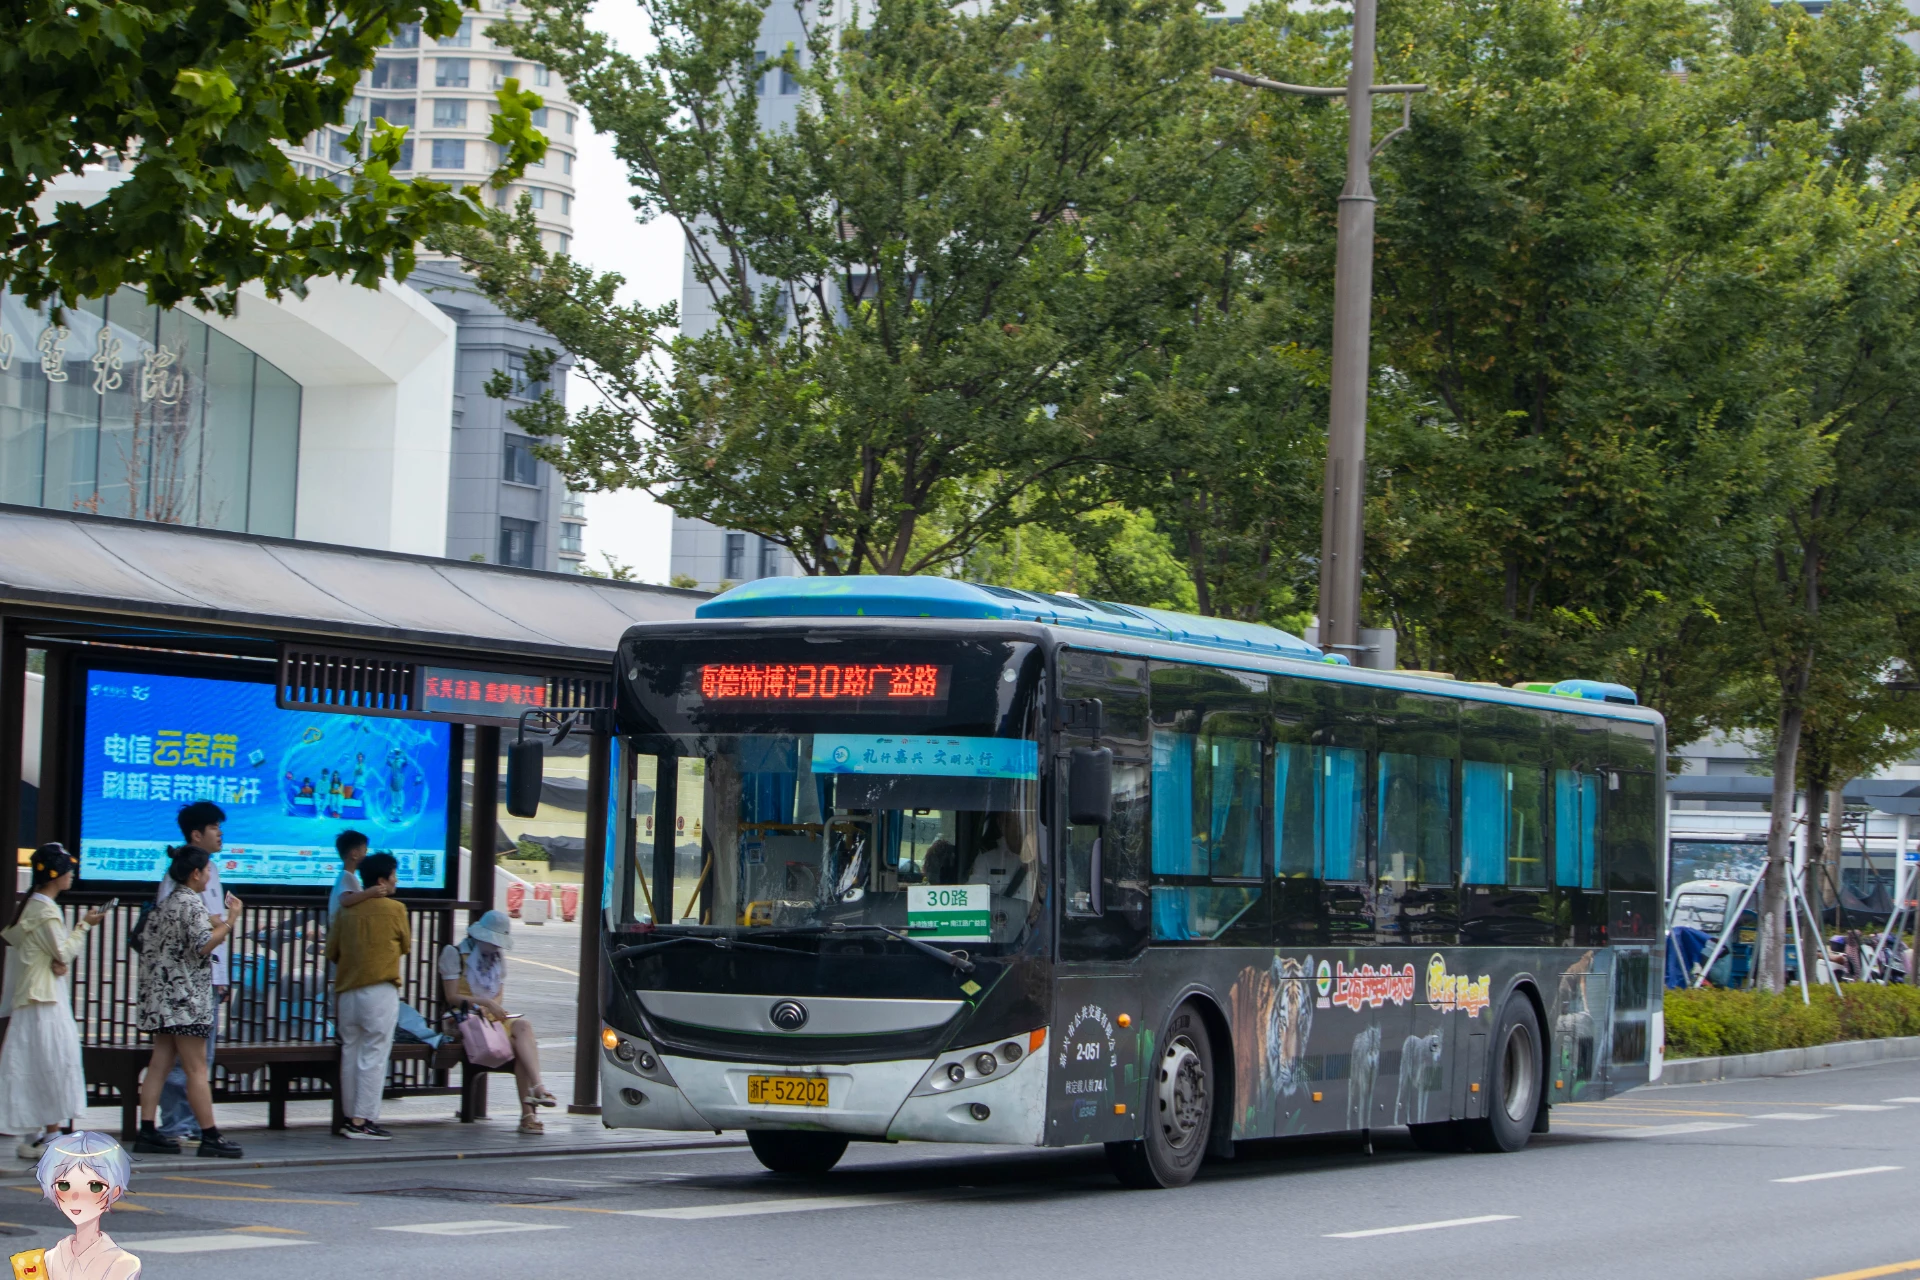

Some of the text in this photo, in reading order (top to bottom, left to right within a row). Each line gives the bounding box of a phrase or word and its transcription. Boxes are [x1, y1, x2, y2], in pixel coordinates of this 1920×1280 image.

[104, 730, 239, 768] 电信云宽带
[933, 749, 994, 766] 文明出行
[927, 889, 968, 907] 30路
[1076, 1042, 1101, 1061] 2-051
